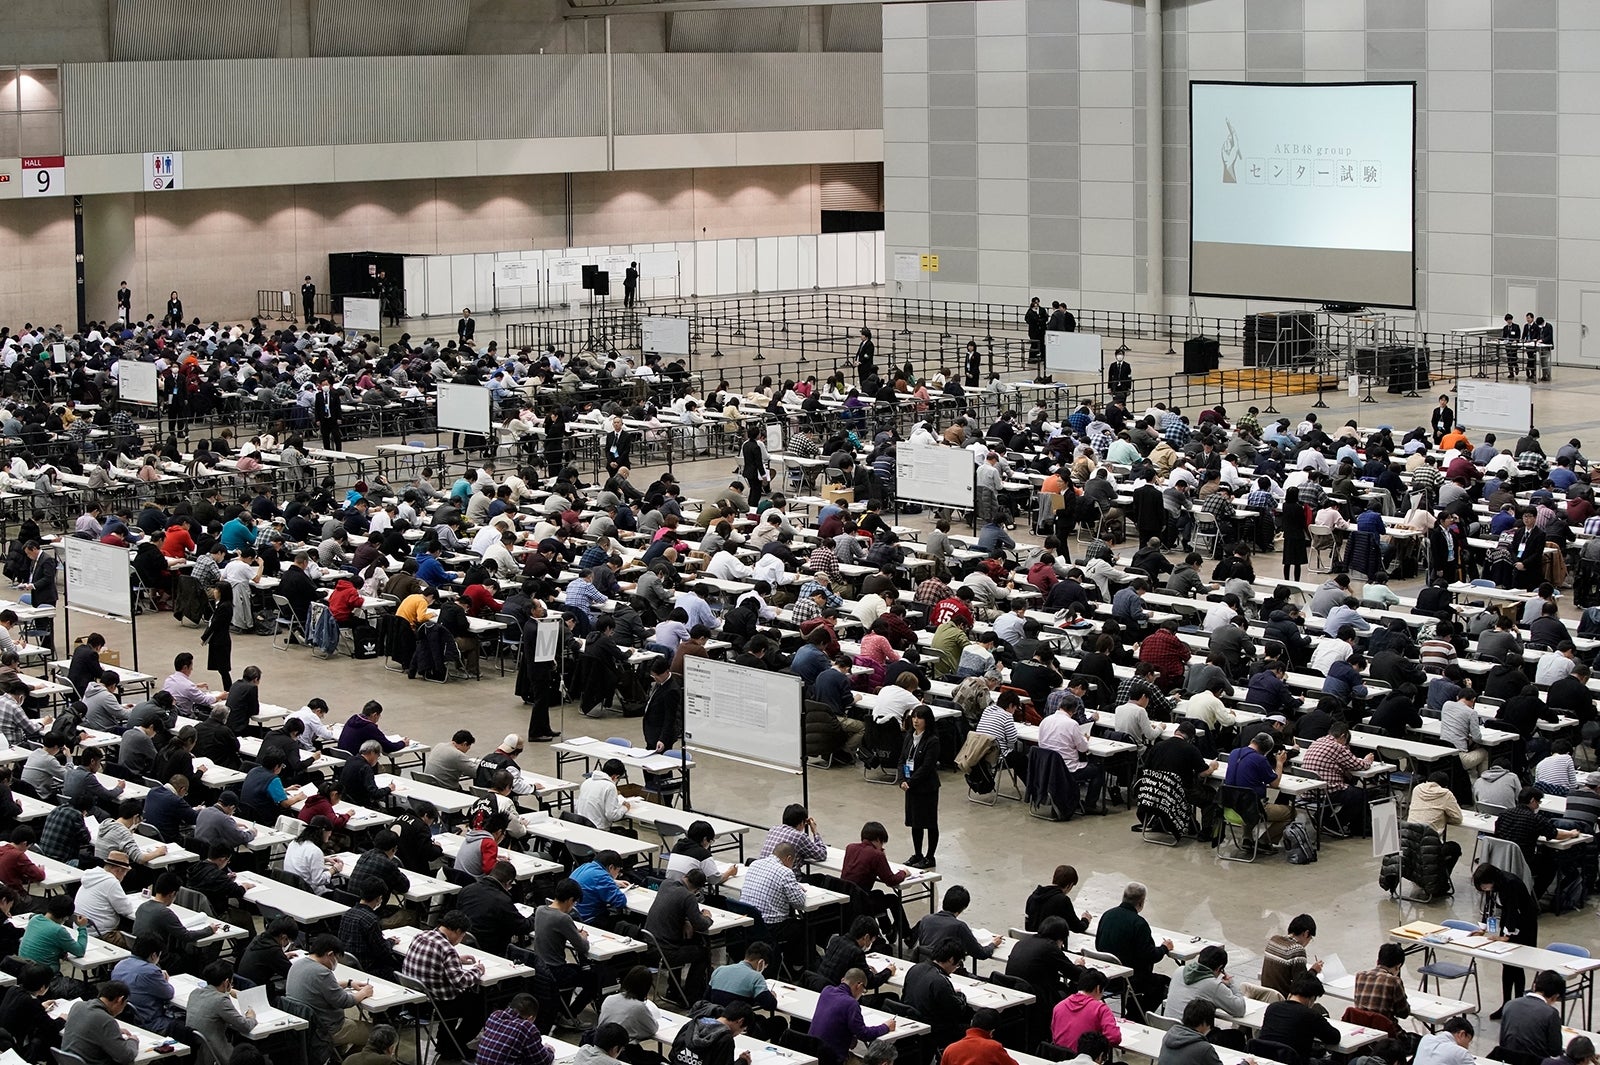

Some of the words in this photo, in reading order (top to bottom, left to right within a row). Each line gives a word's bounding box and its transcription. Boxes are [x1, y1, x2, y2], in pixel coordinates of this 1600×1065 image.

[1274, 143, 1313, 154] AKB48
[1316, 145, 1353, 157] group
[24, 159, 42, 167] HALL
[37, 170, 51, 193] 9
[1249, 163, 1378, 183] センター試験
[936, 609, 954, 624] 15
[536, 630, 558, 657] M
